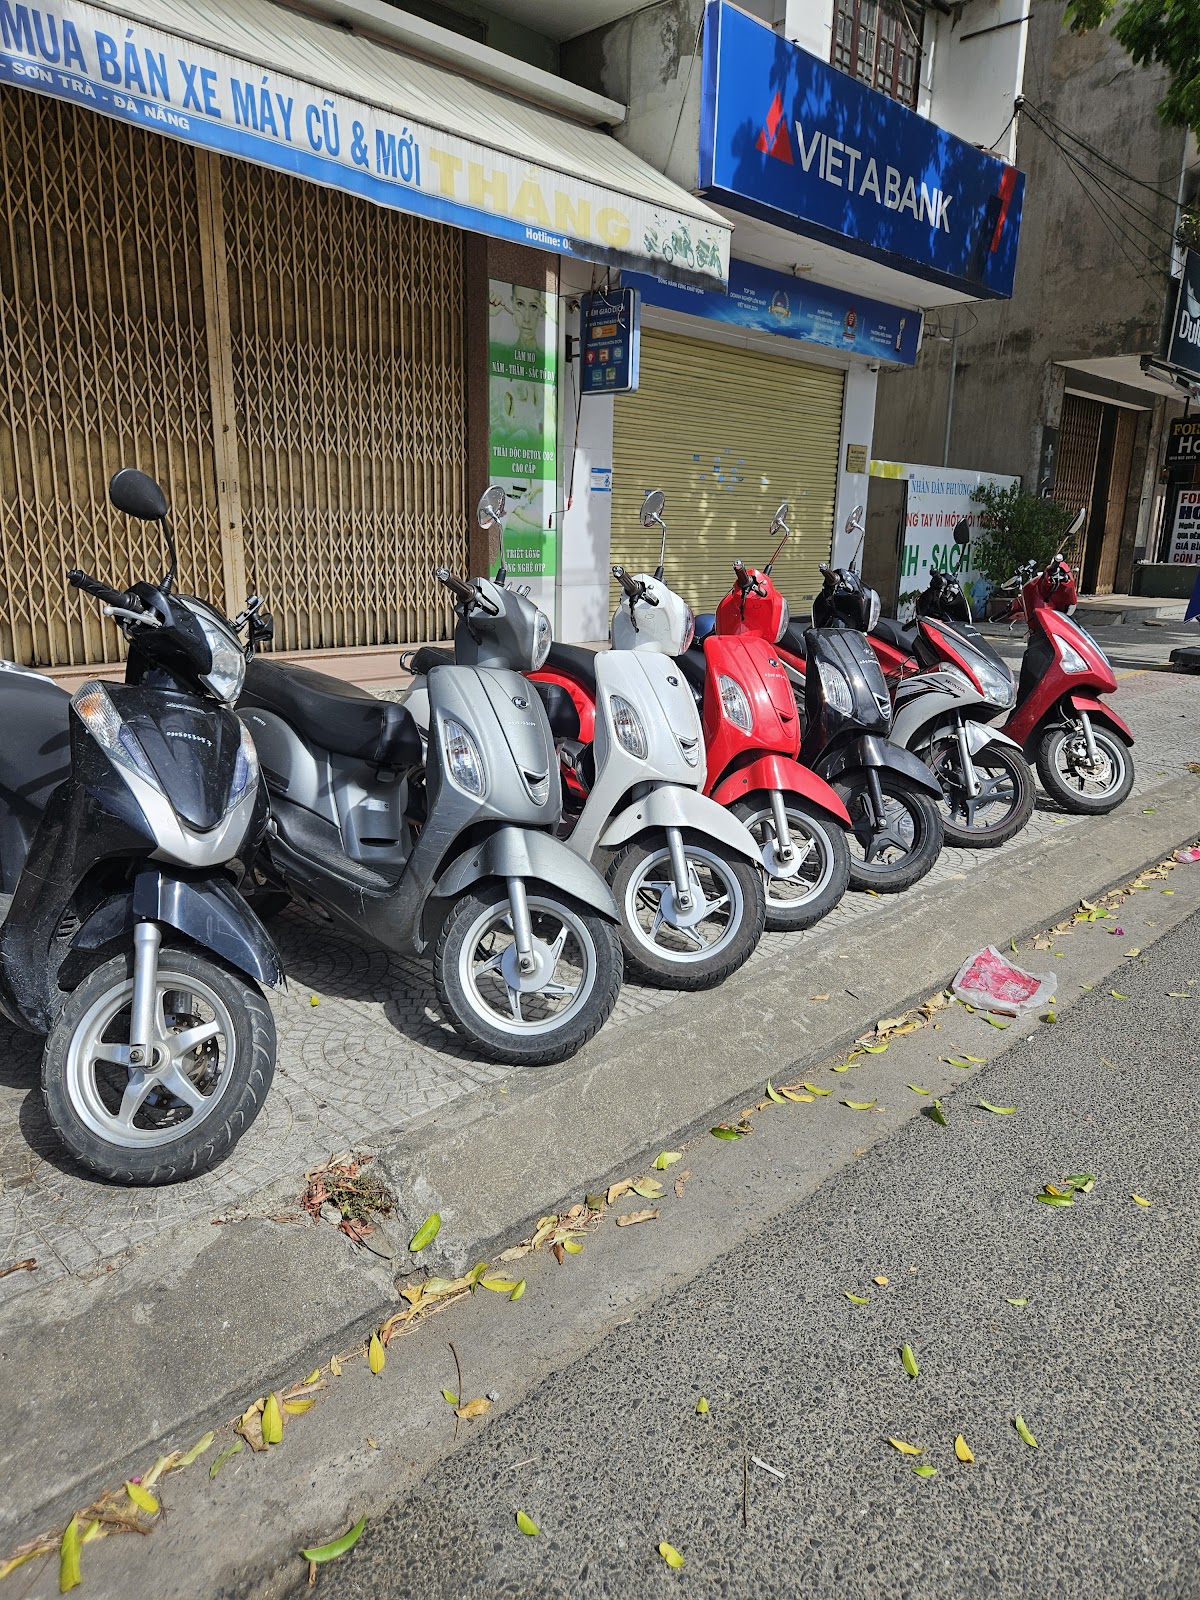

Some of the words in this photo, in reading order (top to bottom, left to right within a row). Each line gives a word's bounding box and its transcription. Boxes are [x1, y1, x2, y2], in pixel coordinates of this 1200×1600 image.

[0, 2, 88, 74] MUA
[95, 28, 170, 103] BÁN
[177, 59, 222, 119] XE
[230, 76, 294, 142] MÁY
[305, 99, 340, 157] CŨ
[351, 120, 369, 169] &
[375, 126, 421, 187] MỚI
[12, 62, 54, 84] SƠN
[58, 74, 97, 100] TRÀ
[113, 95, 139, 114] ĐÀ
[795, 120, 953, 234] VIETABANK
[525, 227, 560, 248] Hotline:
[522, 449, 541, 460] DETOX
[512, 463, 524, 472] CAO
[524, 461, 537, 473] CẤP
[931, 478, 945, 494] DÂN
[921, 513, 934, 527] TAY
[935, 509, 943, 527] VÌ
[1175, 541, 1189, 551] GIÁ
[1173, 551, 1193, 563] CÒN
[945, 679, 966, 693] HONDA
